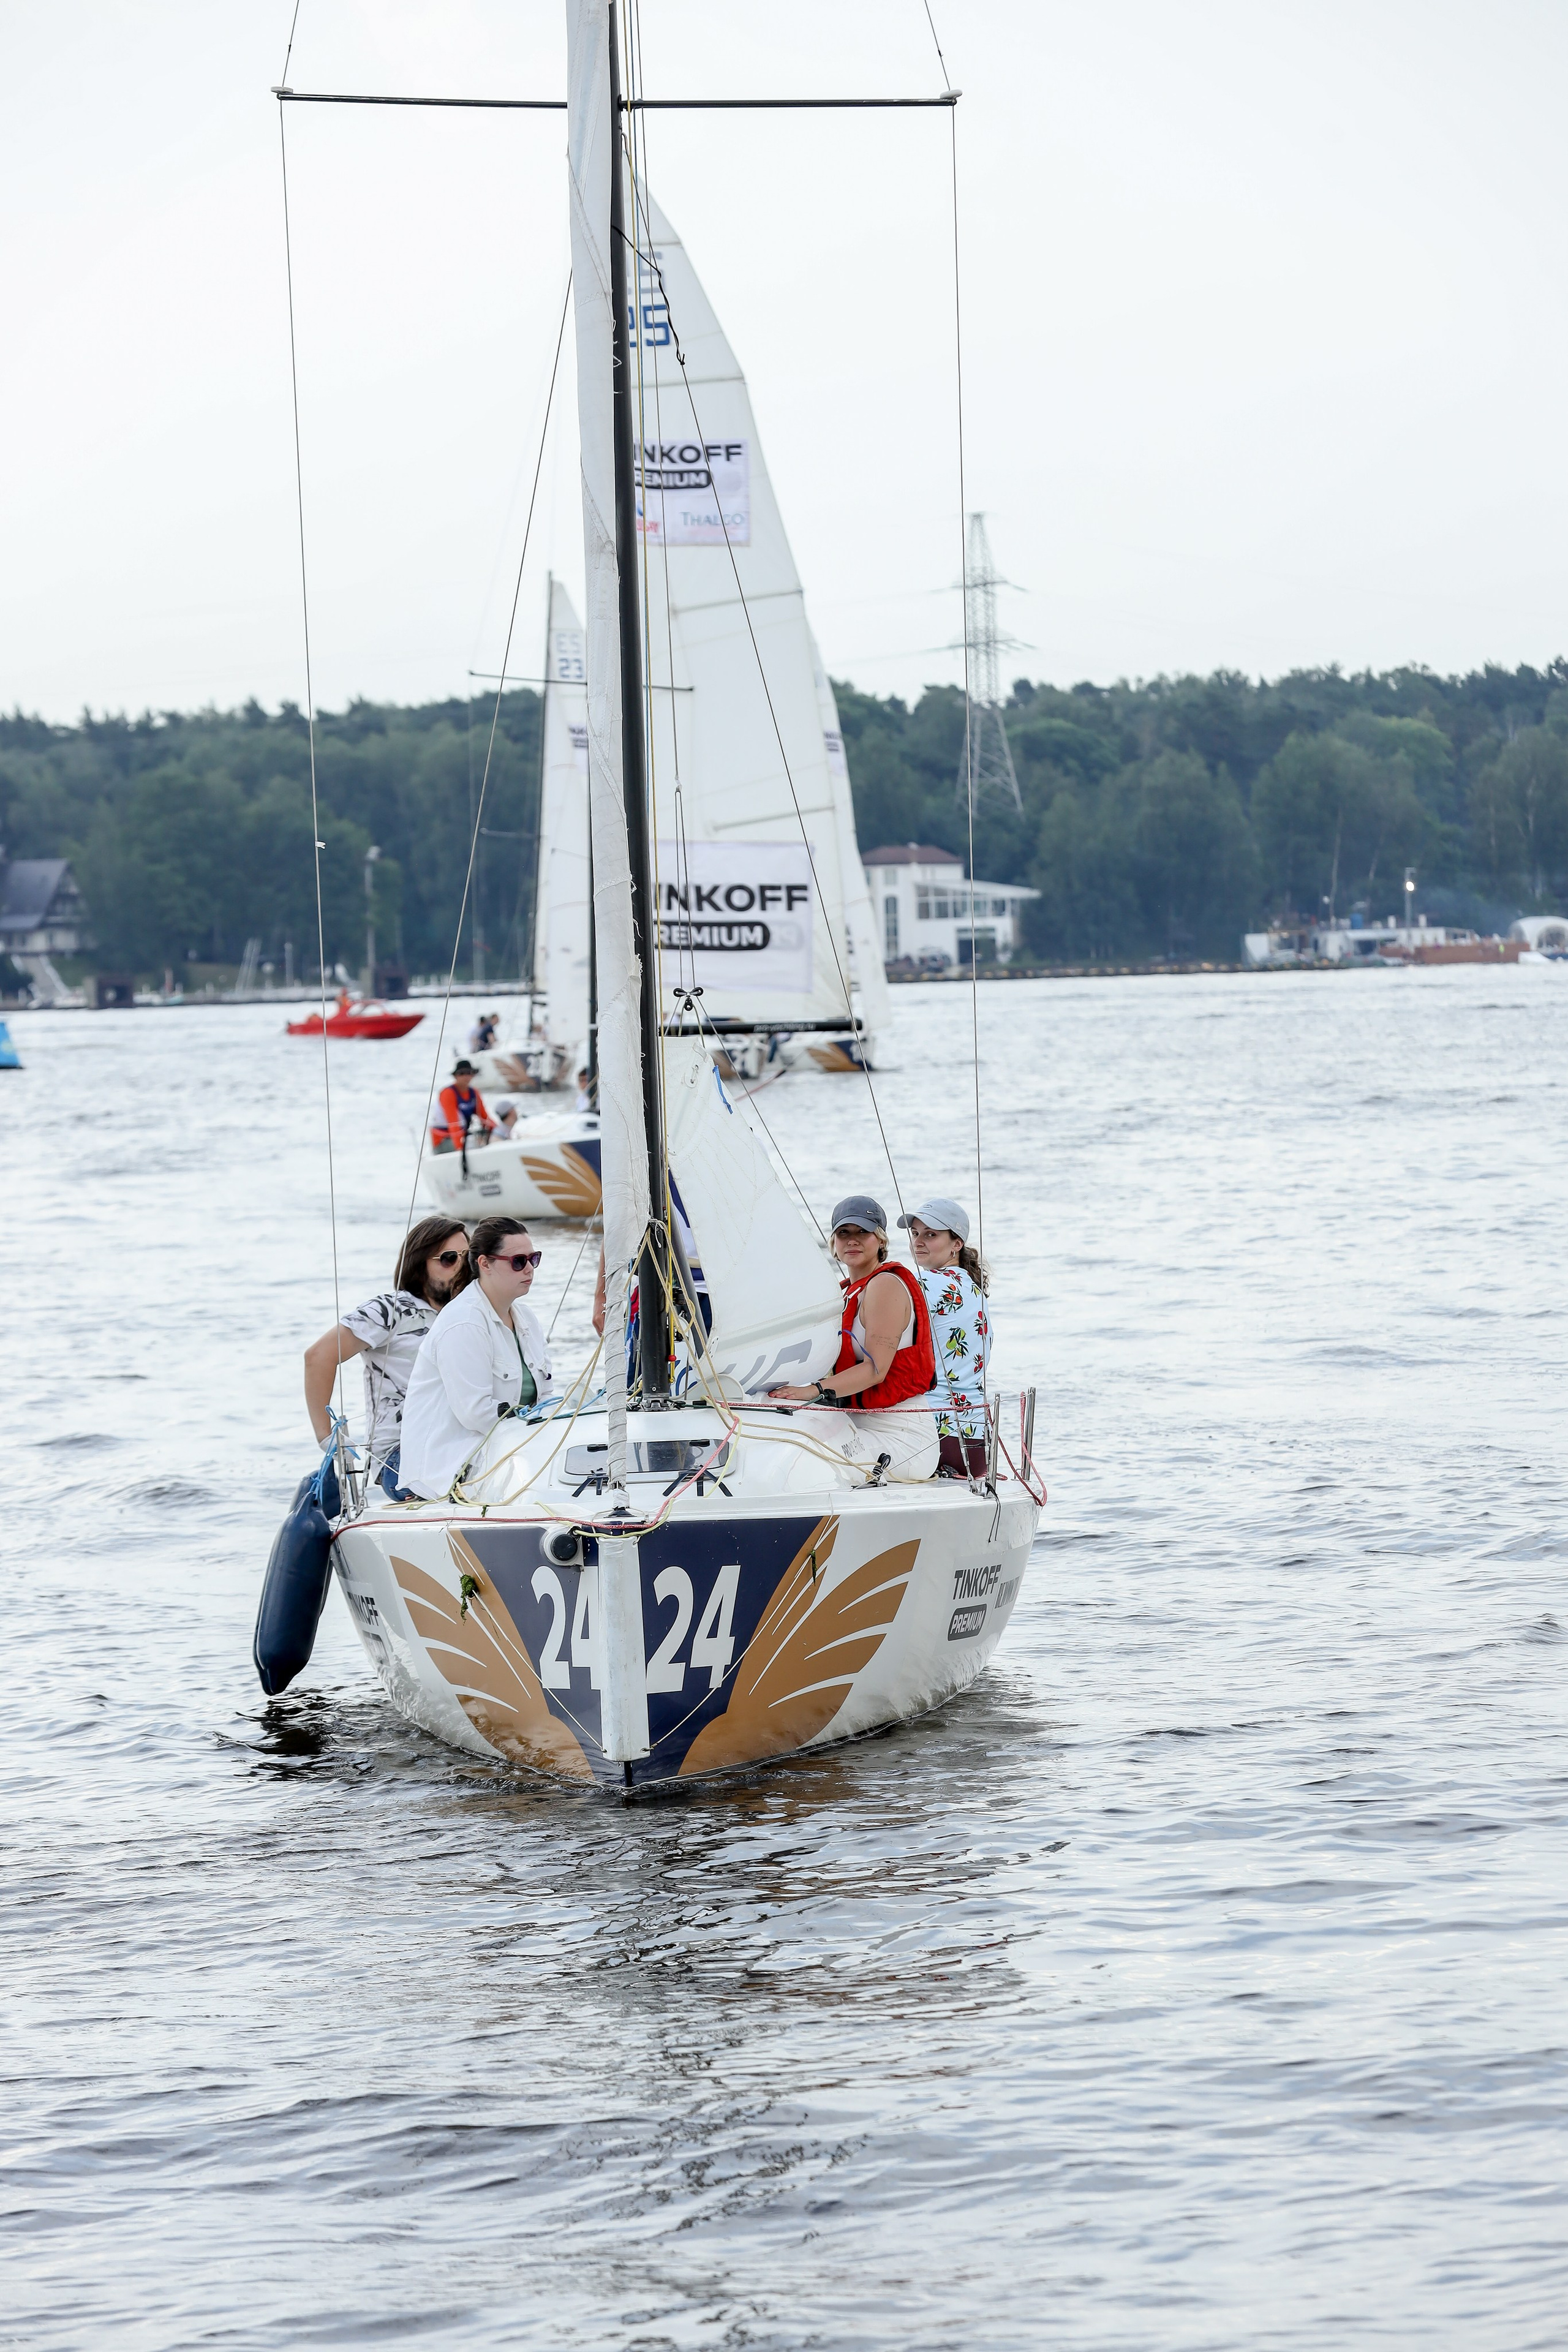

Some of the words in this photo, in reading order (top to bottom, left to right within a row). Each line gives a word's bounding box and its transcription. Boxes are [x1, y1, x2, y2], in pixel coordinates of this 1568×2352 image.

[655, 883, 808, 912] INKOFF
[654, 924, 764, 947] REMIUM
[952, 1564, 1002, 1600] TINKOFF
[646, 1566, 741, 1694] 24
[949, 1610, 986, 1635] PREMIUM
